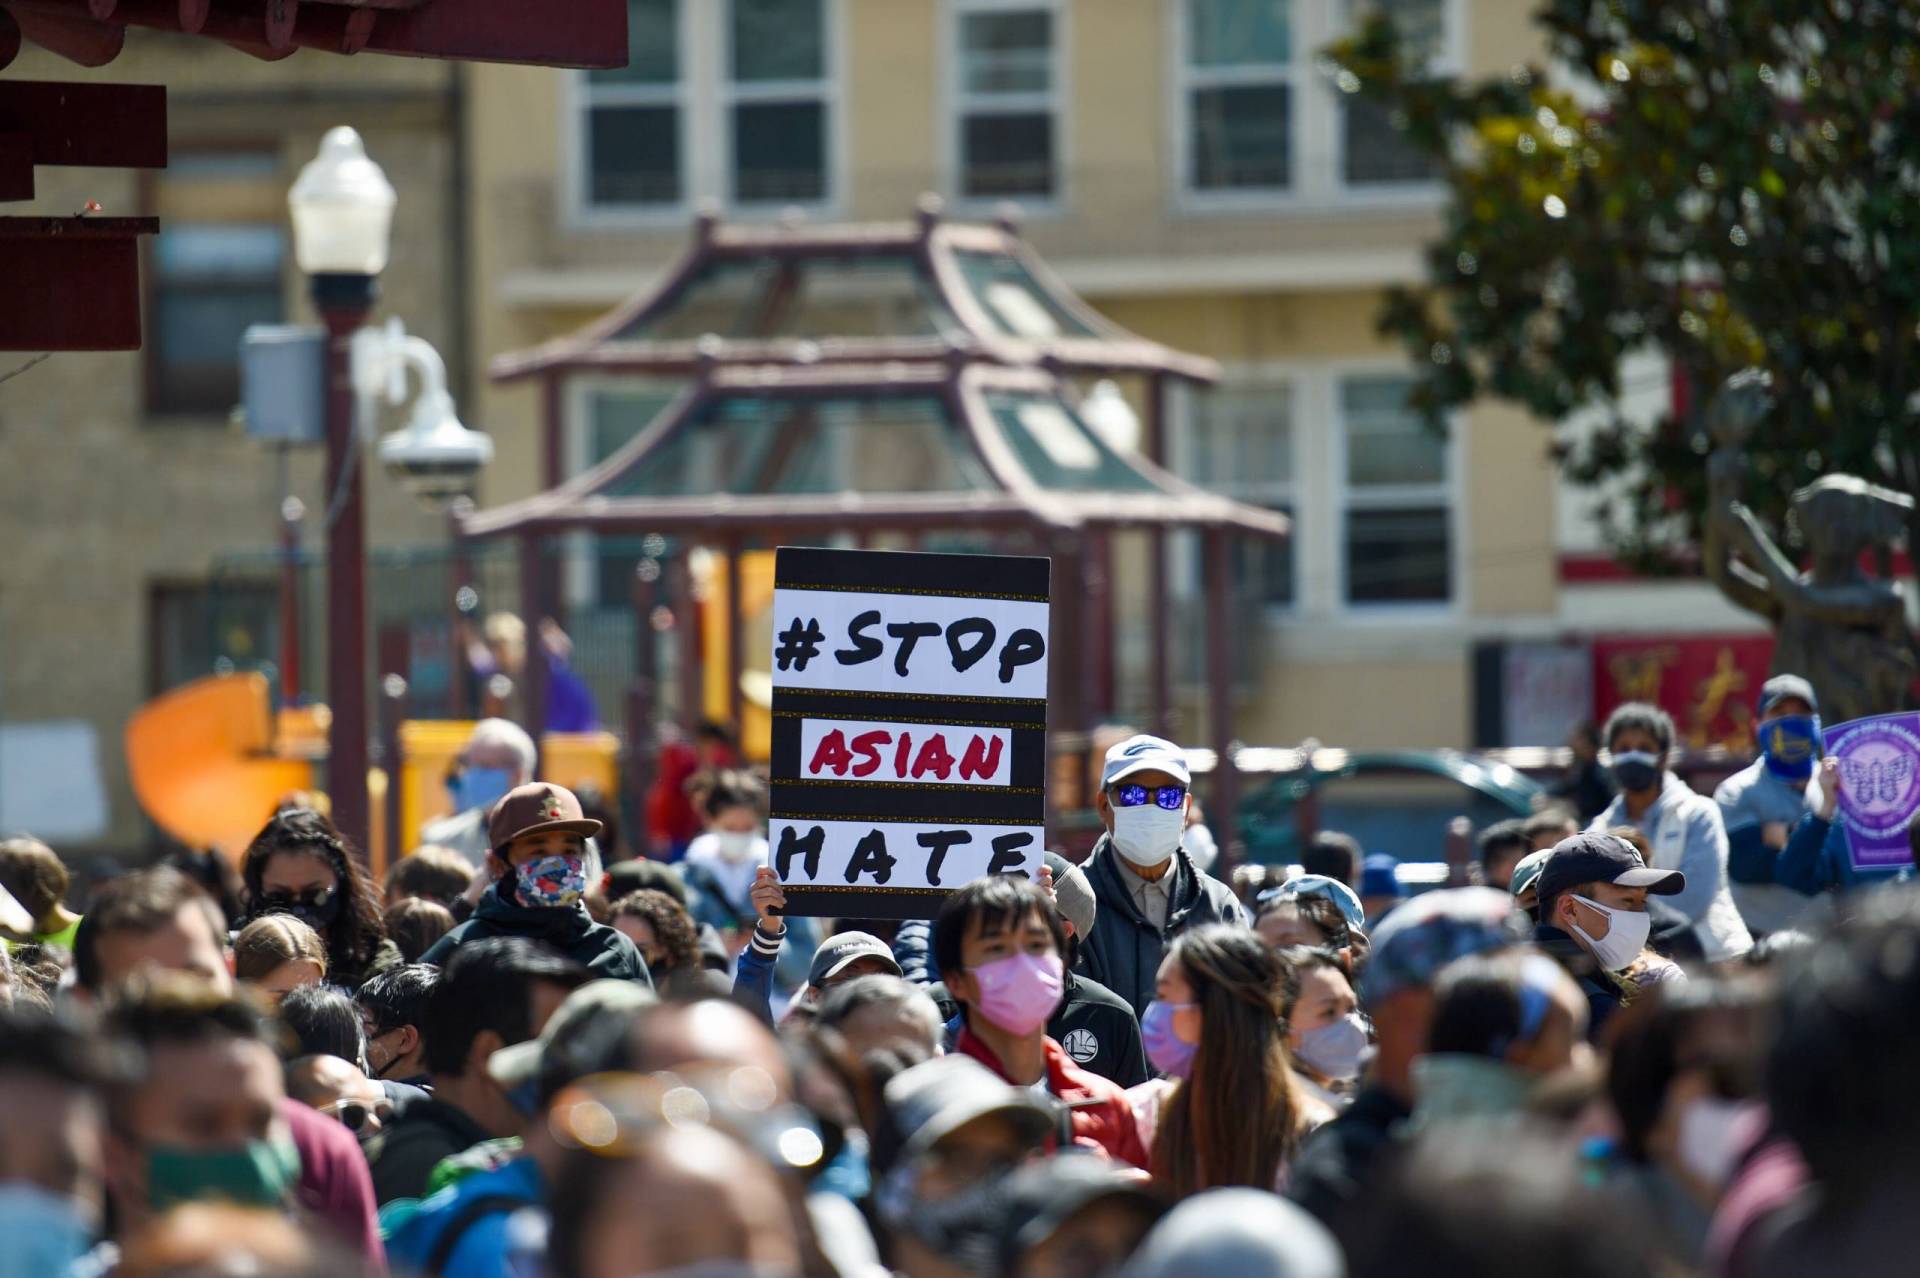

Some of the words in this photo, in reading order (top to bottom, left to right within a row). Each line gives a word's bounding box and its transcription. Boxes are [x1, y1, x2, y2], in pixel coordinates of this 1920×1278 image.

[775, 610, 1046, 684] #STOP
[808, 728, 1004, 781] ASIAN
[774, 825, 1034, 886] HATE
